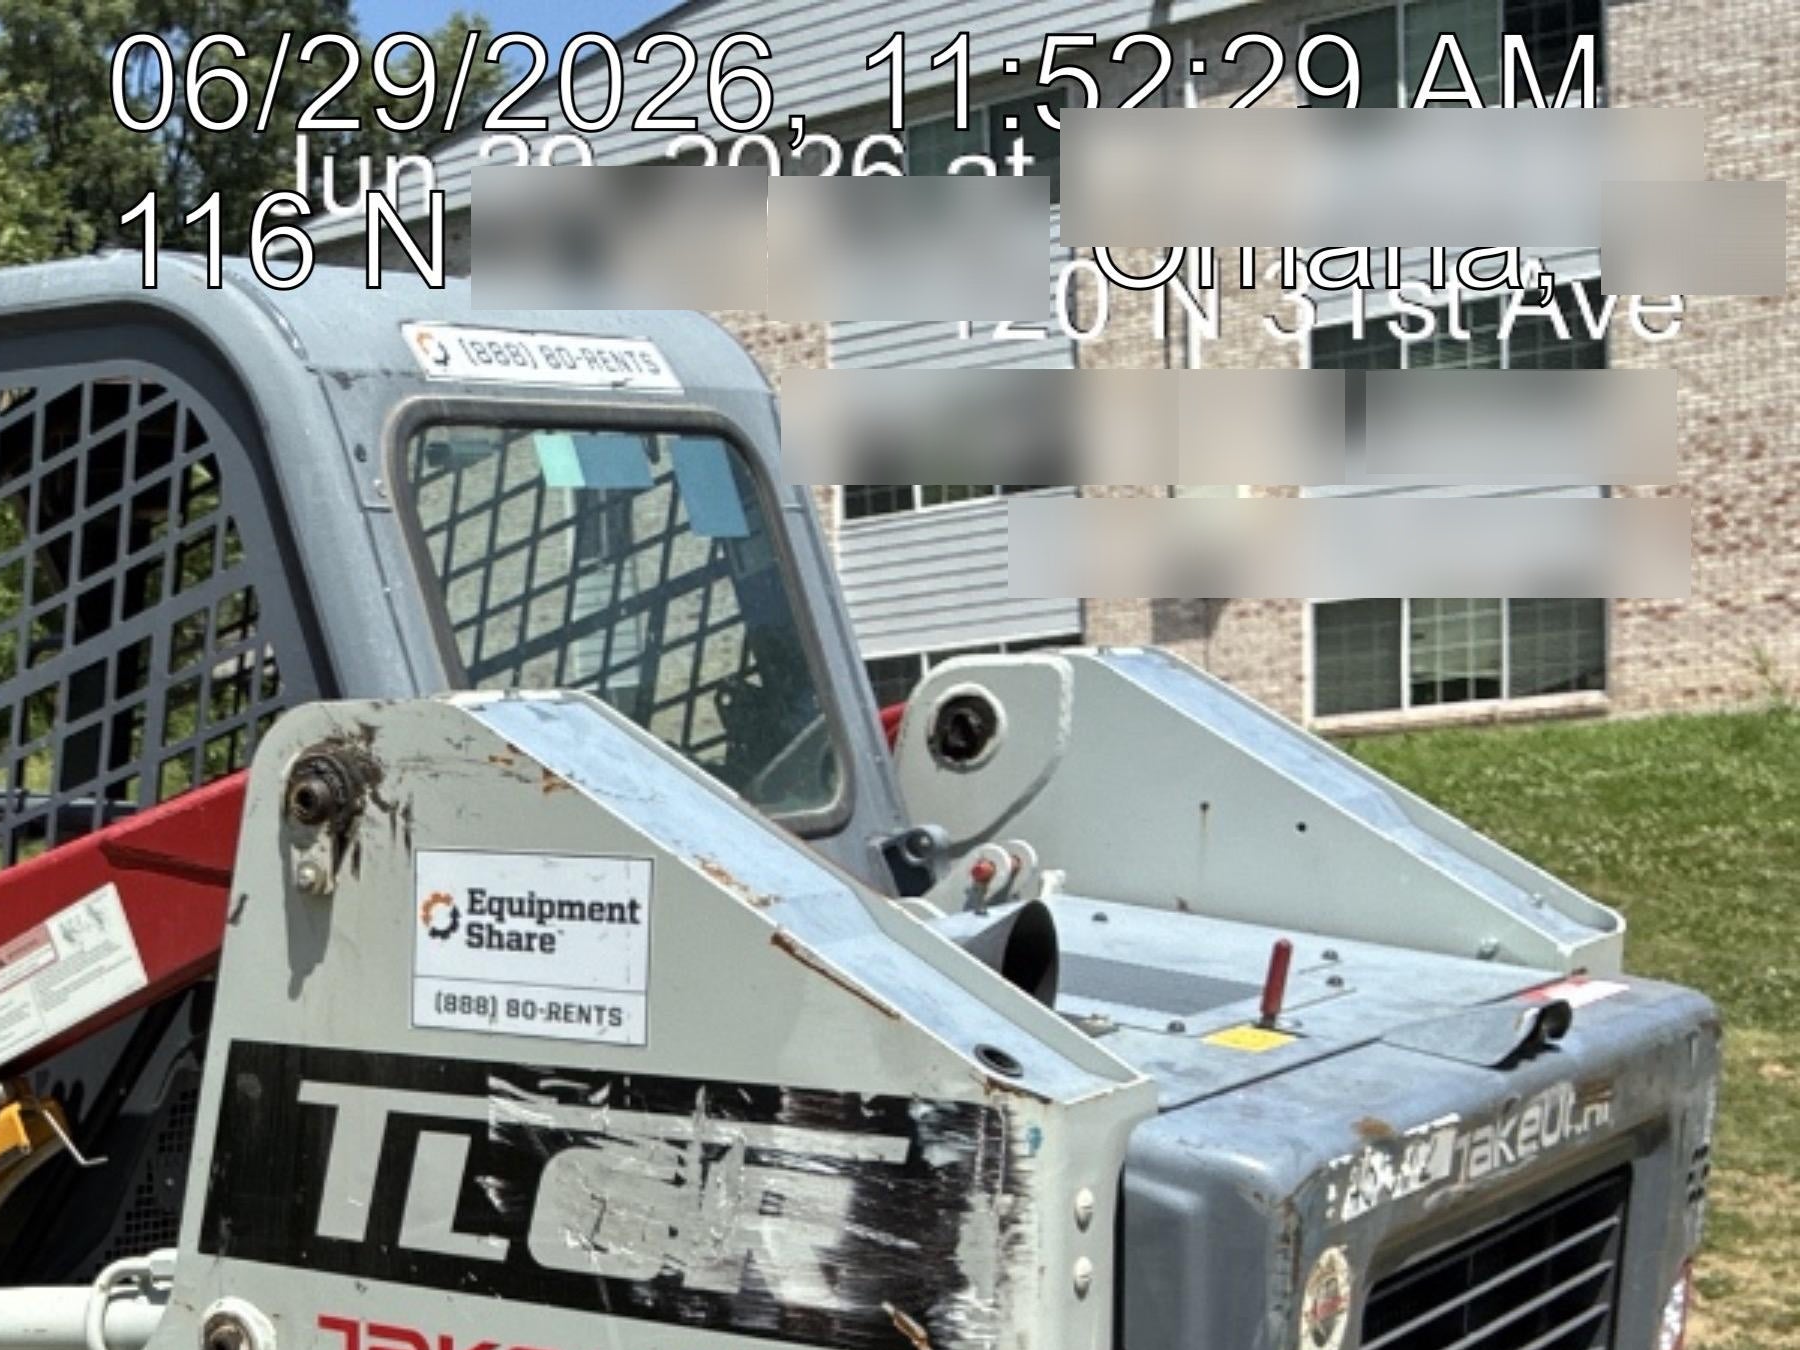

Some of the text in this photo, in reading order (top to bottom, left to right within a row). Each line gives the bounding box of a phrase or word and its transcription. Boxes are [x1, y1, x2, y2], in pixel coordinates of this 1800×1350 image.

[458, 337, 539, 370] (888)
[466, 886, 641, 926] Equipment
[434, 990, 623, 1027] (888) 80-RENTS
